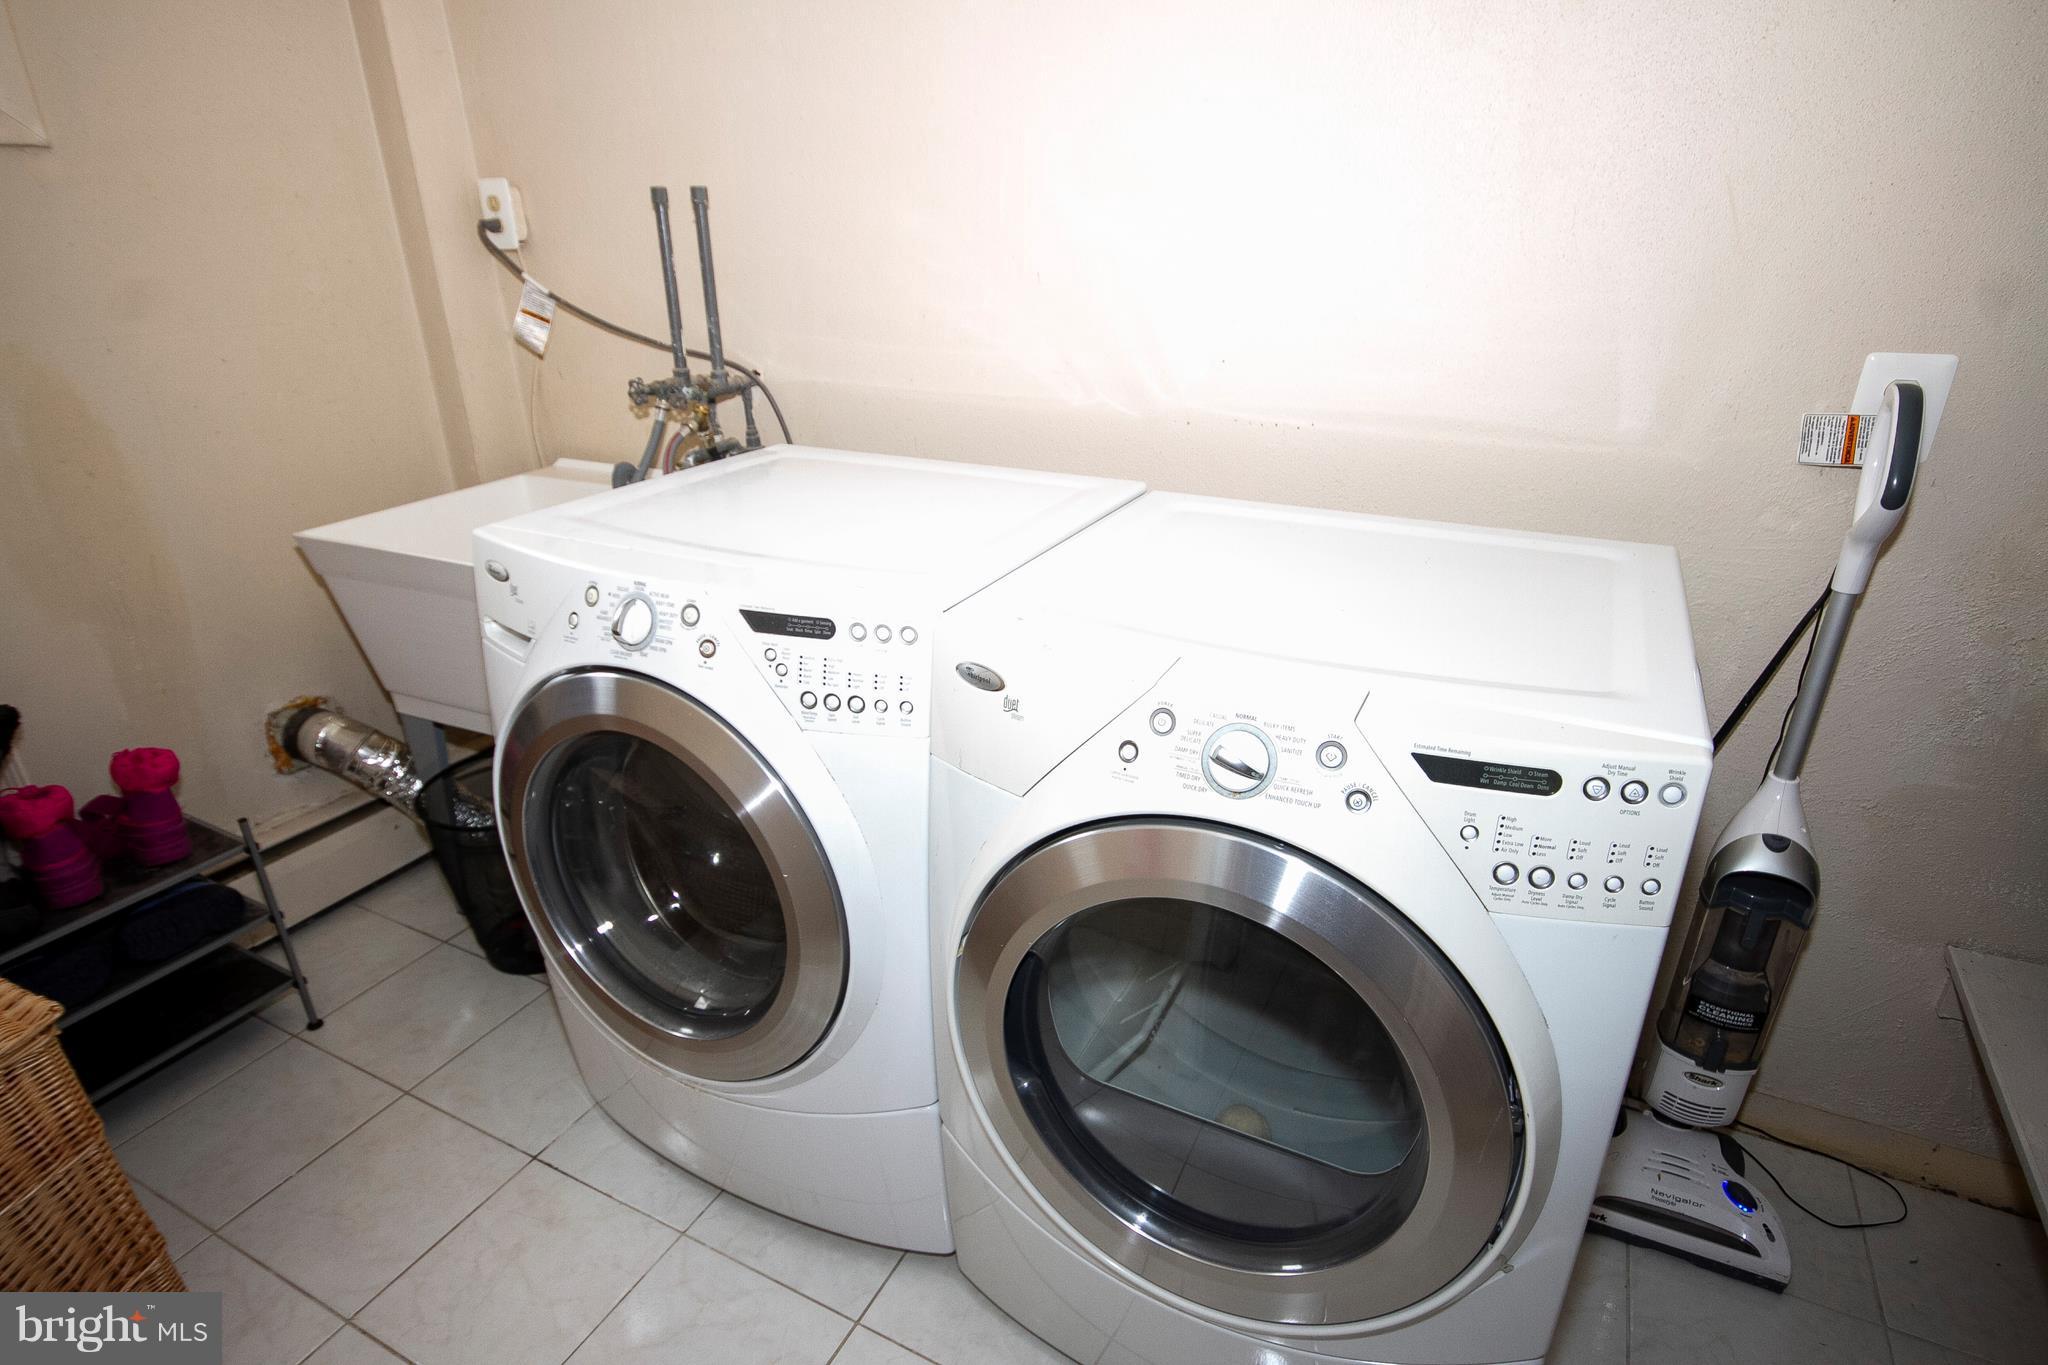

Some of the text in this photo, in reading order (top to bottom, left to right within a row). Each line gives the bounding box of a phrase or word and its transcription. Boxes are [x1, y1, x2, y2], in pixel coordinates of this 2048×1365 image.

[1234, 712, 1257, 721] NORMAL
[1698, 1004, 1754, 1023] CLEANING
[1688, 1072, 1717, 1086] Shark
[1650, 1187, 1705, 1208] Navigator
[1589, 1212, 1607, 1222] ark
